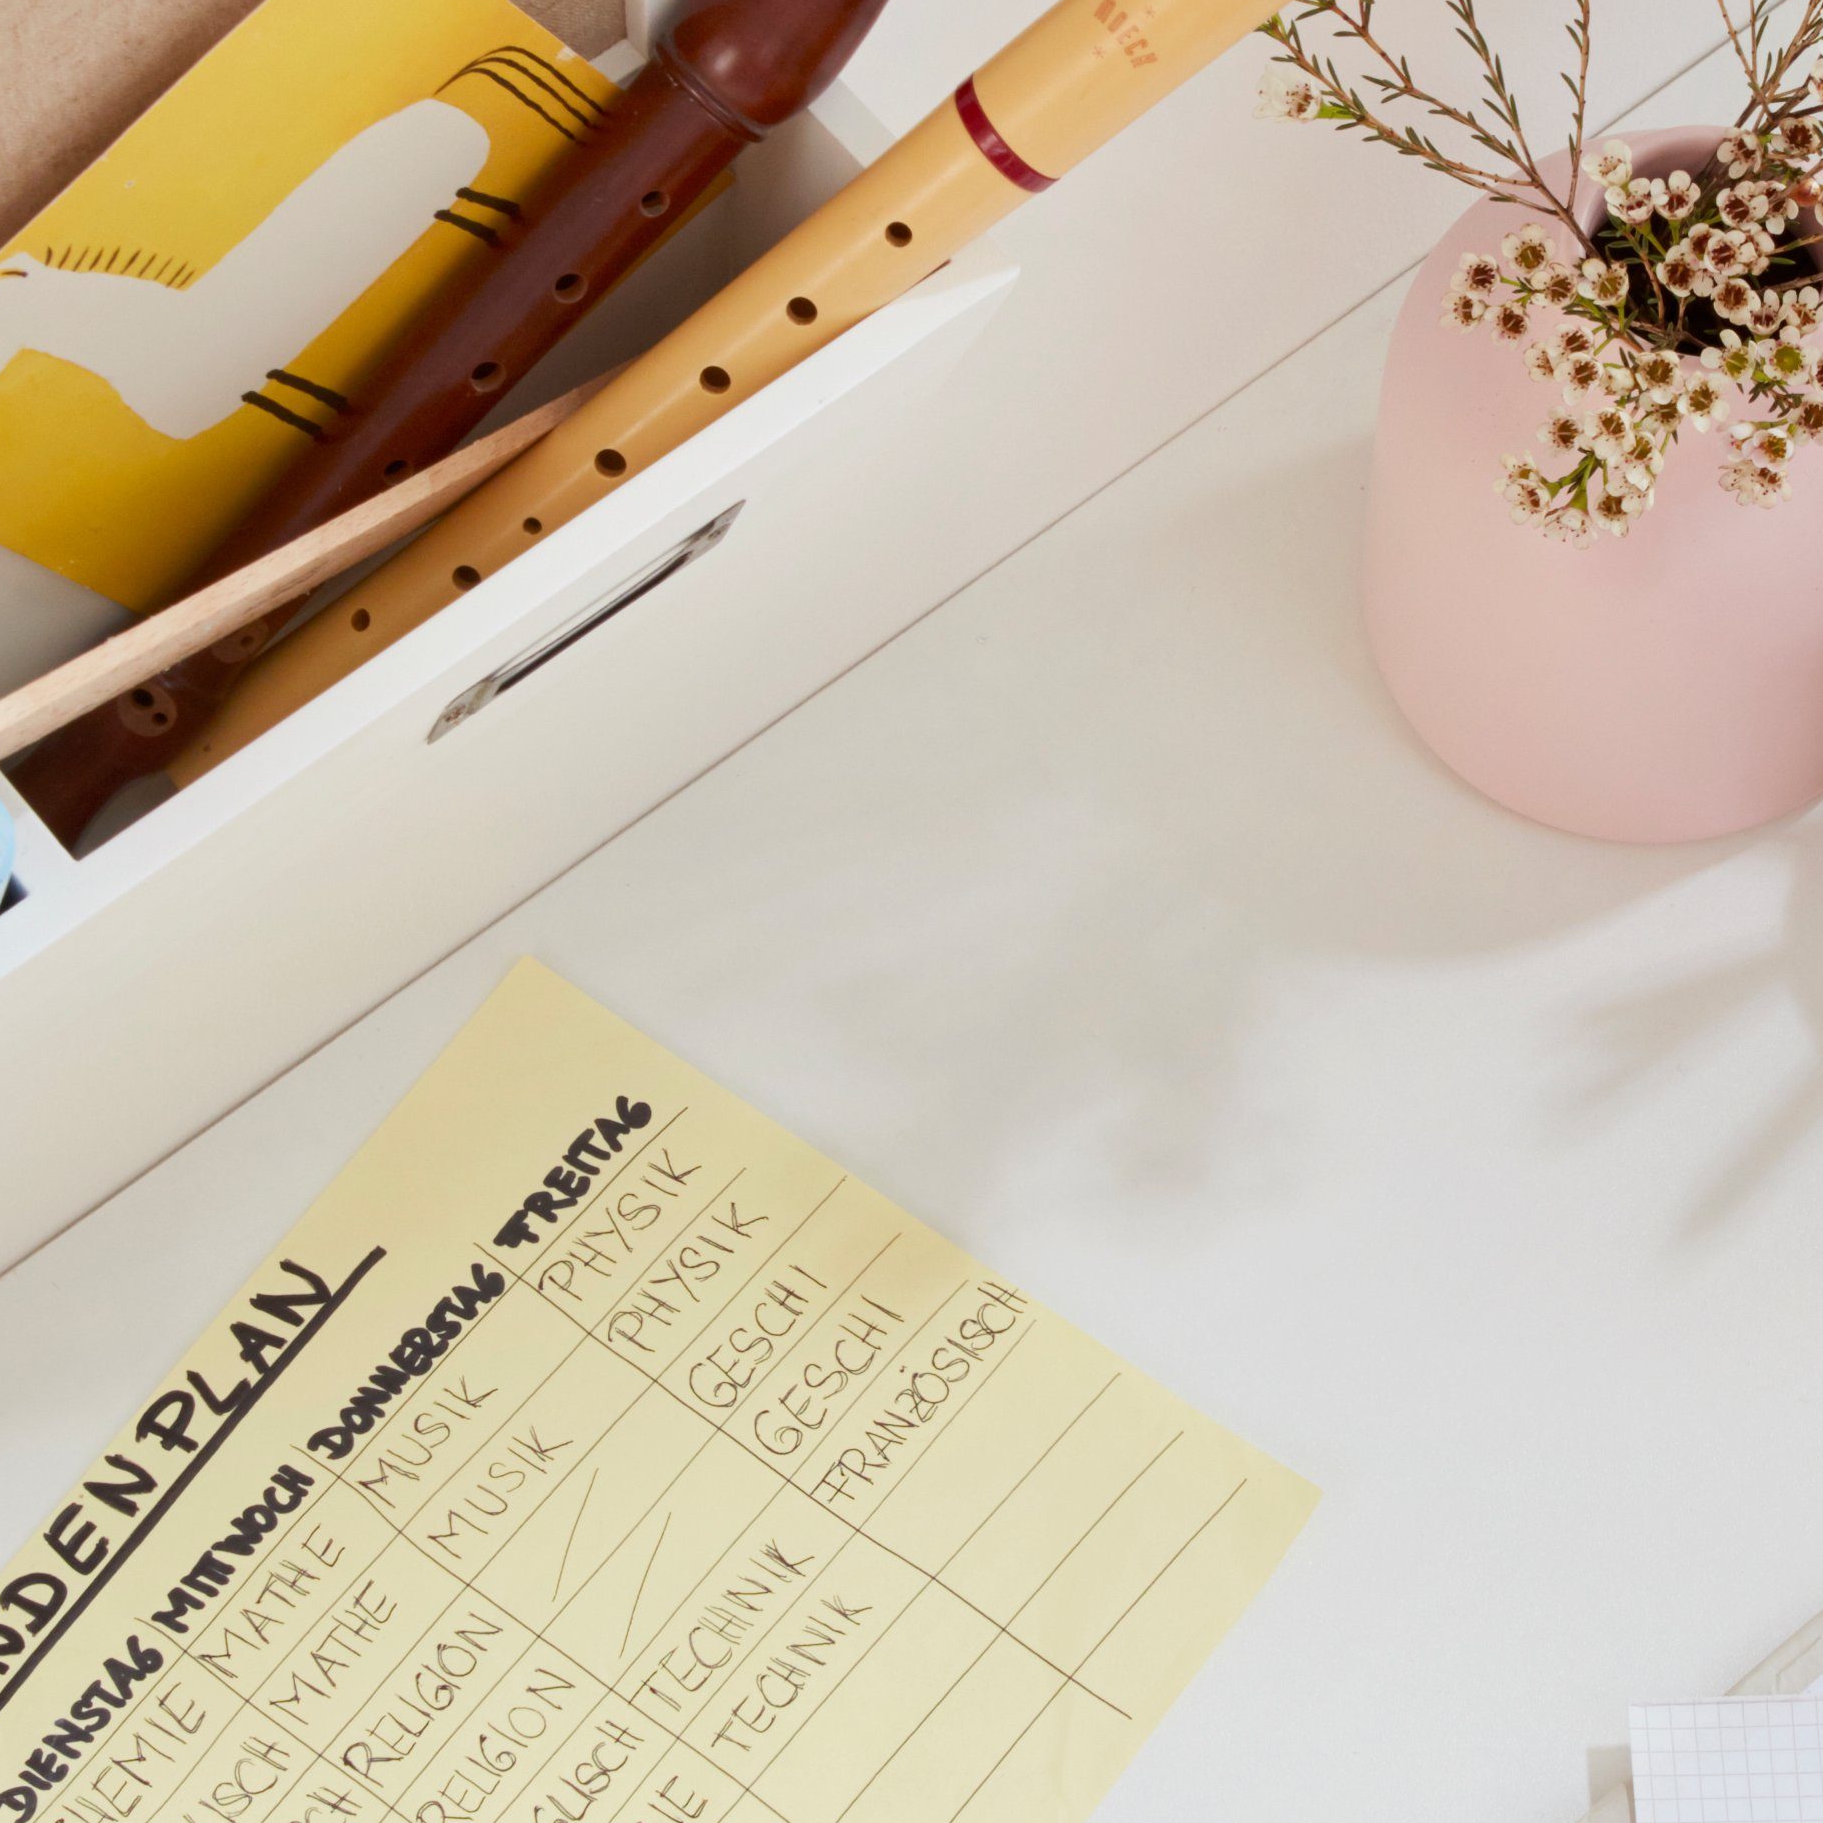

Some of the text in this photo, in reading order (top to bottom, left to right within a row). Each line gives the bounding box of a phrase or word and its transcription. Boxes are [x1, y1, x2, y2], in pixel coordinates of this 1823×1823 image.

[150, 1464, 315, 1634] MITTWOCH
[306, 1262, 505, 1460] DONNERSTAG
[492, 1095, 652, 1249] FREITAG
[197, 1522, 346, 1680] MATHE
[354, 1374, 499, 1510] MUSIK
[535, 1146, 703, 1320] PHYSIK
[267, 1577, 398, 1726] MATHE
[425, 1424, 575, 1560] MUSIK
[605, 1200, 770, 1371] PHYSIK
[630, 1537, 816, 1712] TECHNIK
[808, 1279, 1029, 1506] FRANZÖSISCH
[338, 1610, 504, 1798] RELIGION
[709, 1594, 874, 1753] TECHNIK
